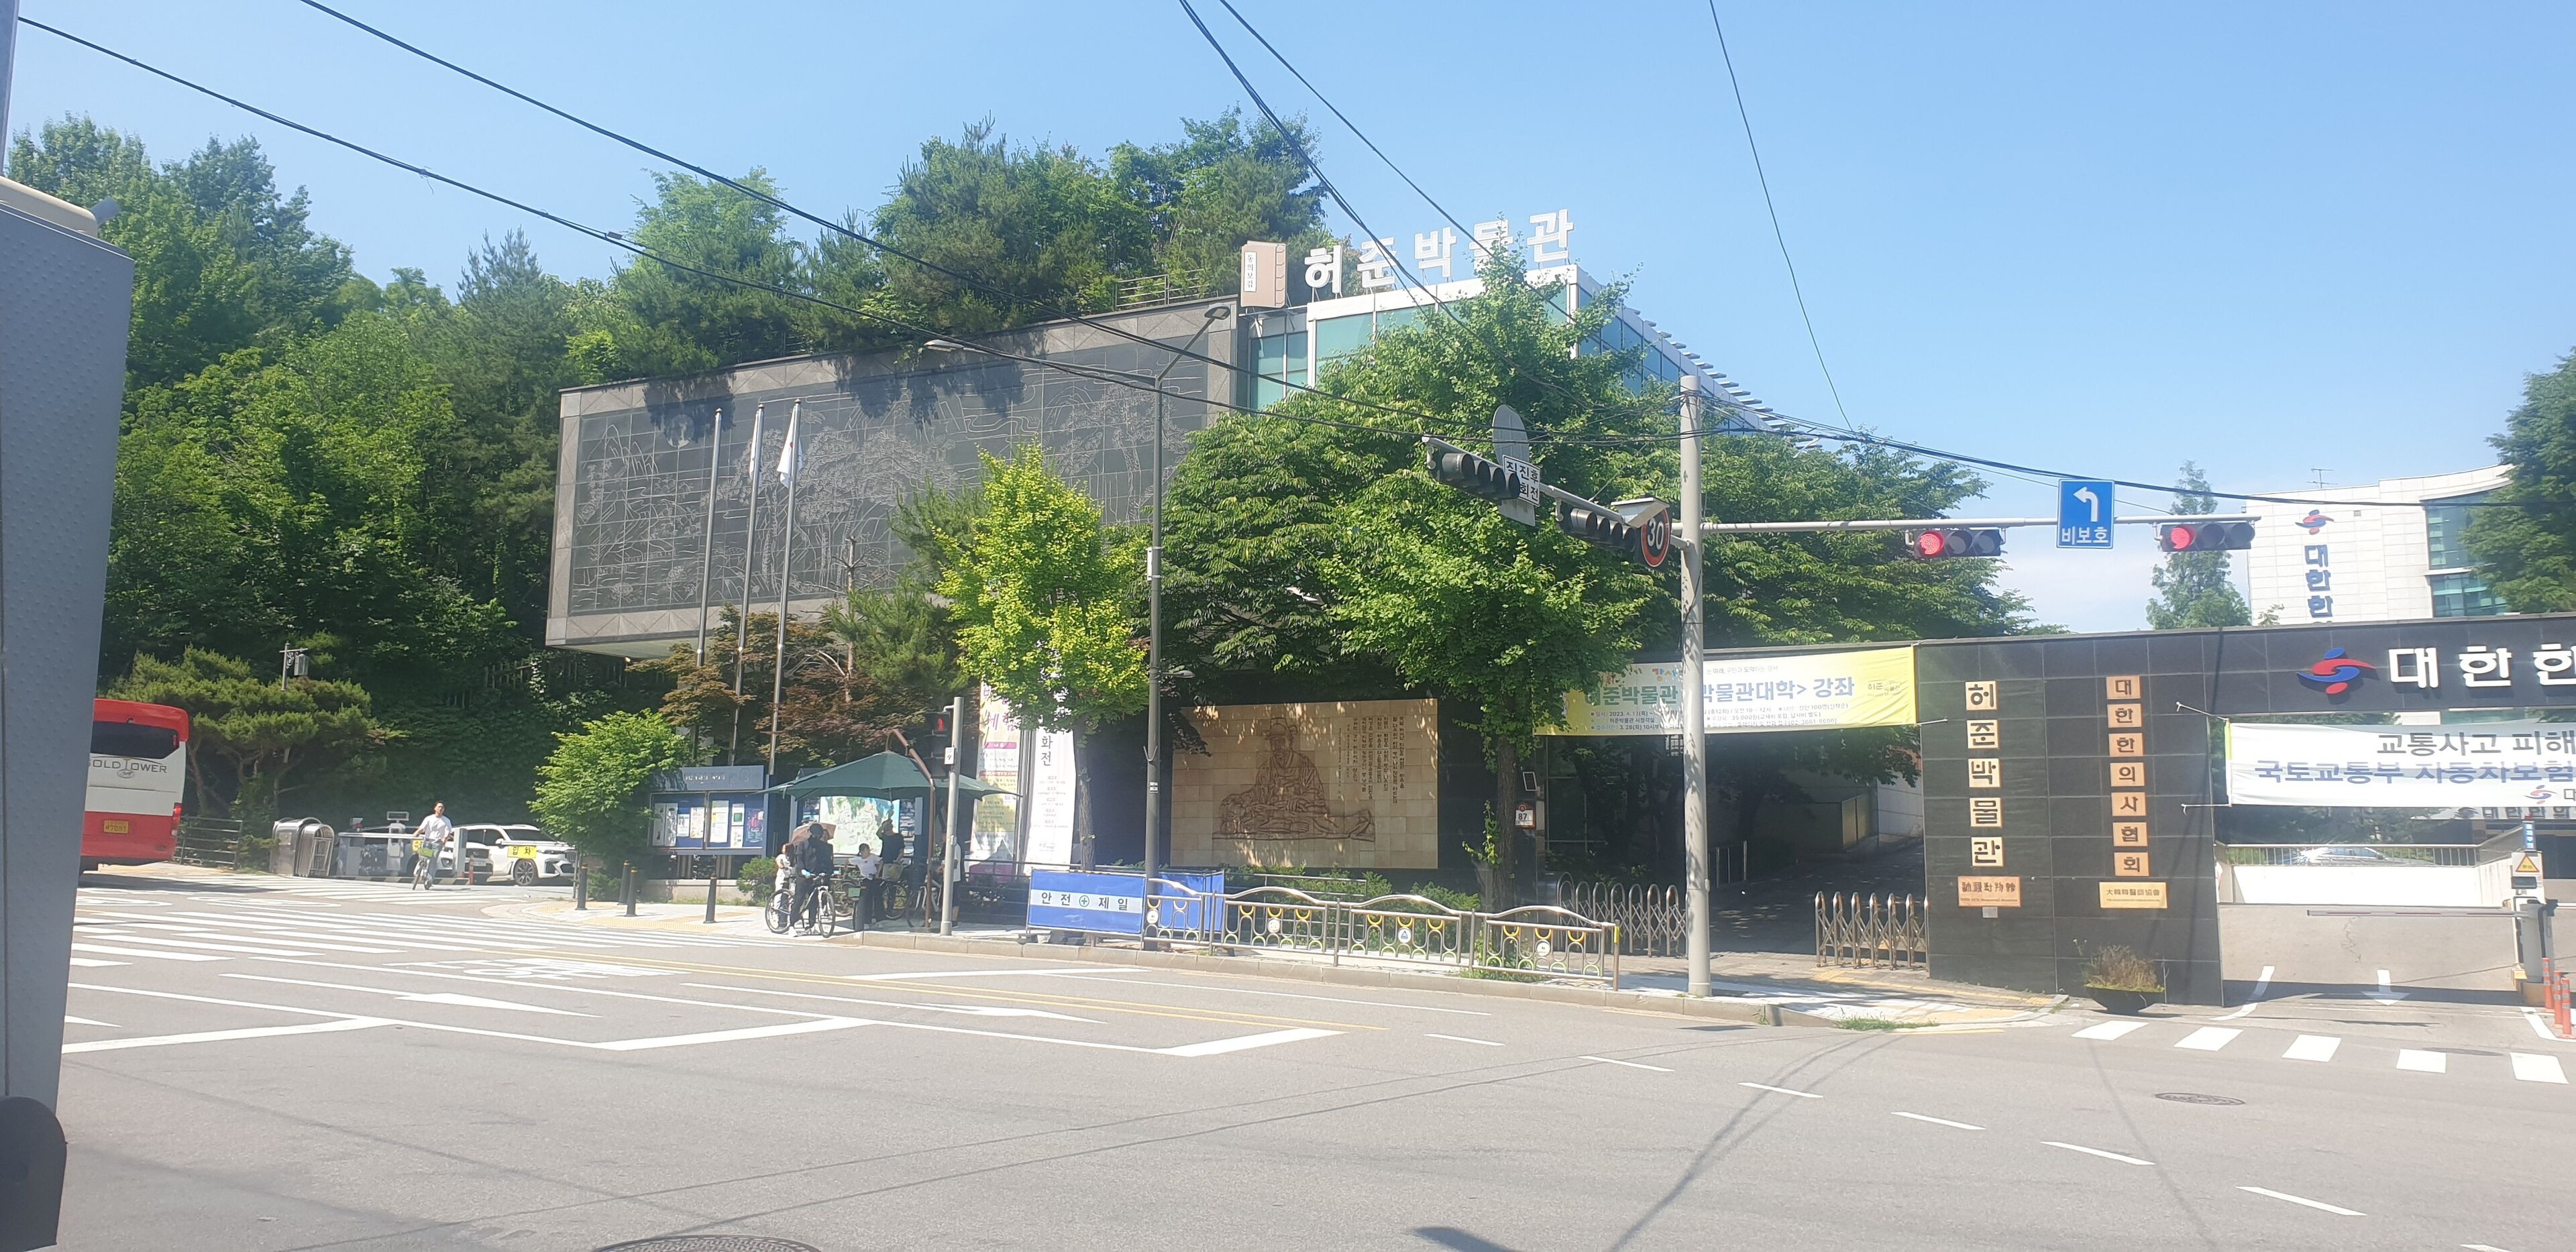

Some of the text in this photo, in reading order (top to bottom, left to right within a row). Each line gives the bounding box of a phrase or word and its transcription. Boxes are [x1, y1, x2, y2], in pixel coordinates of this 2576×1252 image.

[1304, 209, 1574, 294] 허준박물관
[1520, 482, 1538, 502] 회전
[1648, 517, 1664, 551] 30
[2061, 526, 2109, 545] 비보호
[2304, 544, 2334, 622] 대한한
[1813, 677, 1855, 698] 강좌
[1041, 728, 1053, 766] 화전
[2376, 730, 2576, 756] 교통사고 피해
[89, 759, 121, 769] OLD
[1968, 683, 2000, 864] 허준박물관
[2114, 679, 2141, 872] 대한한의사협회
[2255, 760, 2574, 785] 국토교통부 자동차보험
[1041, 892, 1128, 911] 안전 제일
